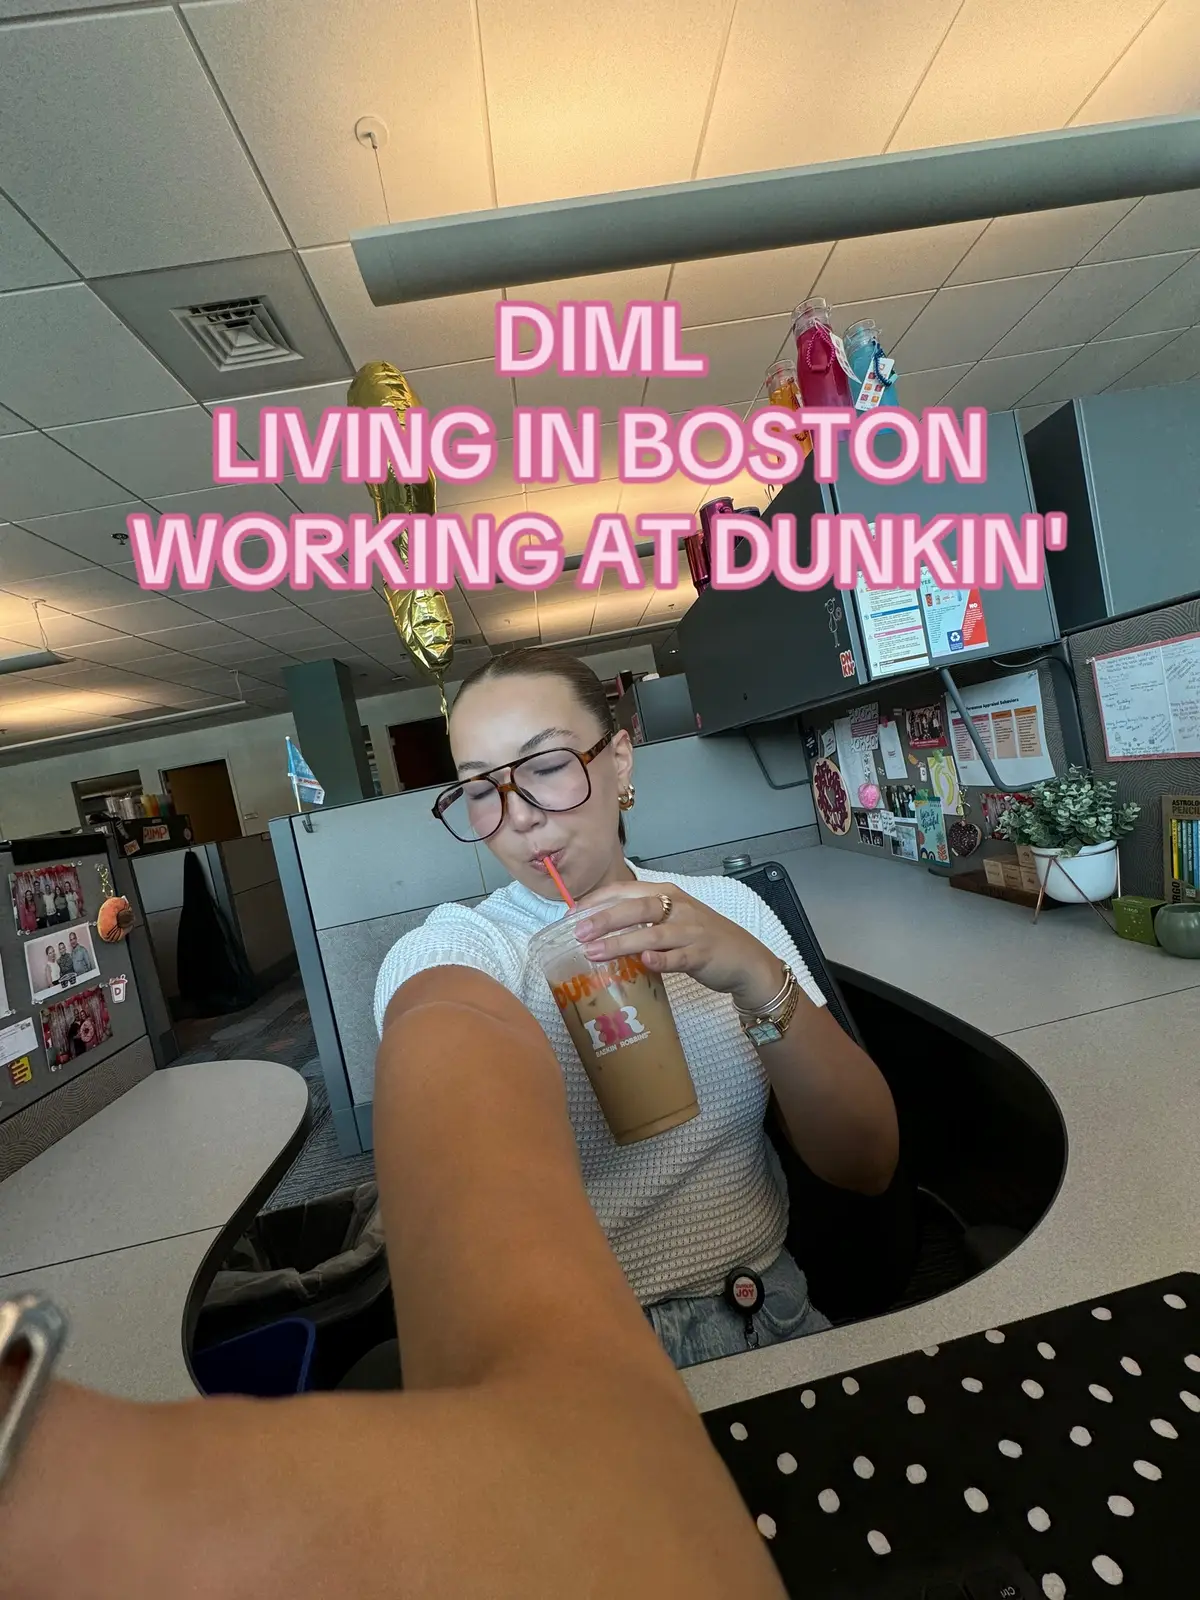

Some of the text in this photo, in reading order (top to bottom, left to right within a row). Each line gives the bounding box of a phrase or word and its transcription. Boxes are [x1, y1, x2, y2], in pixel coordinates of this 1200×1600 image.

[1172, 806, 1200, 815] PENCIL
[736, 1289, 754, 1297] JOY
[1000, 1586, 1015, 1598] Ctrl
